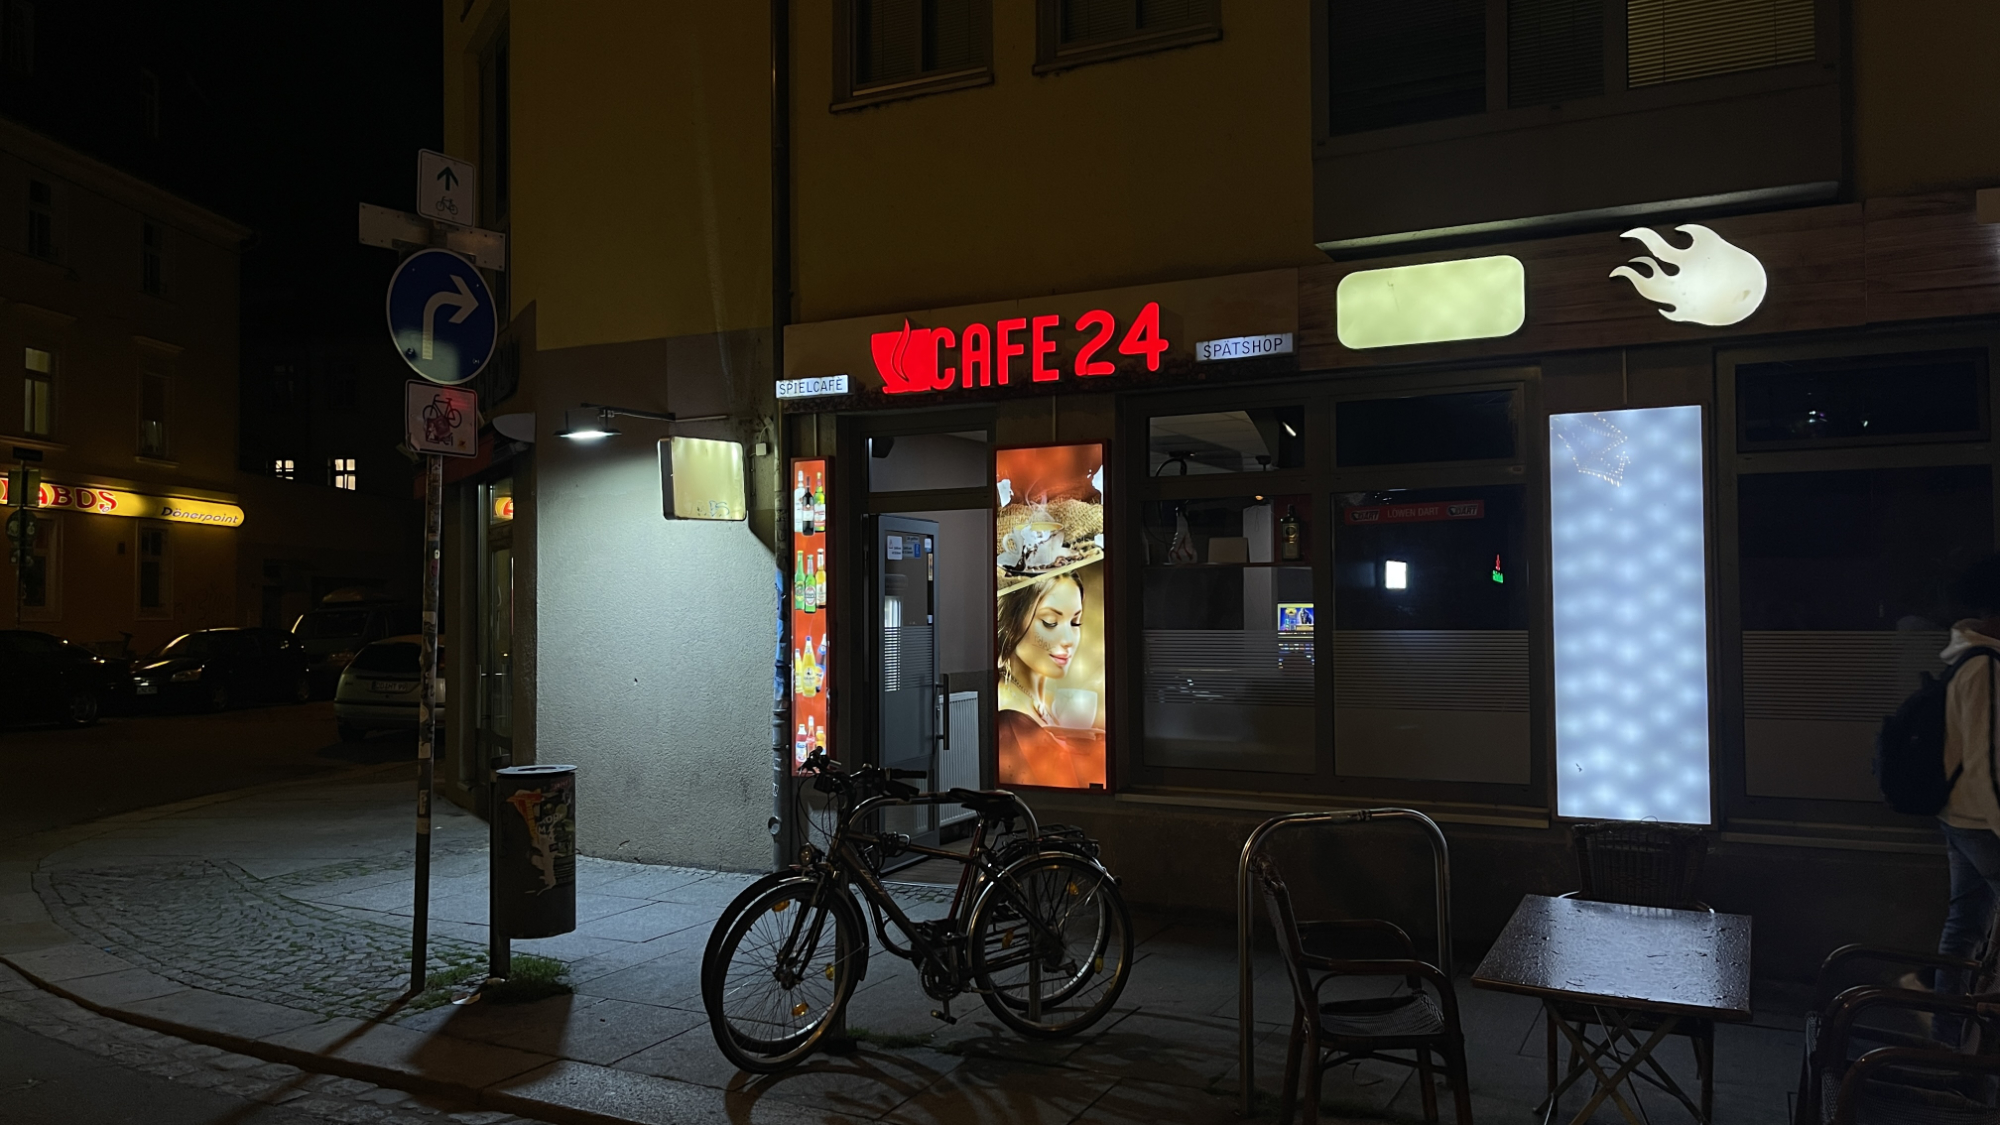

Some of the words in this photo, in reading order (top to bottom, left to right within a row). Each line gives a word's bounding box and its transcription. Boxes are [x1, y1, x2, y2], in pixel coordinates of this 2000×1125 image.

[930, 314, 1060, 390] CAFE
[1075, 302, 1169, 376] 24
[1203, 337, 1283, 358] SPÄTSHOP
[161, 506, 239, 524] Dönerpoint
[1387, 508, 1416, 519] LÖWEN
[1418, 506, 1440, 517] DART
